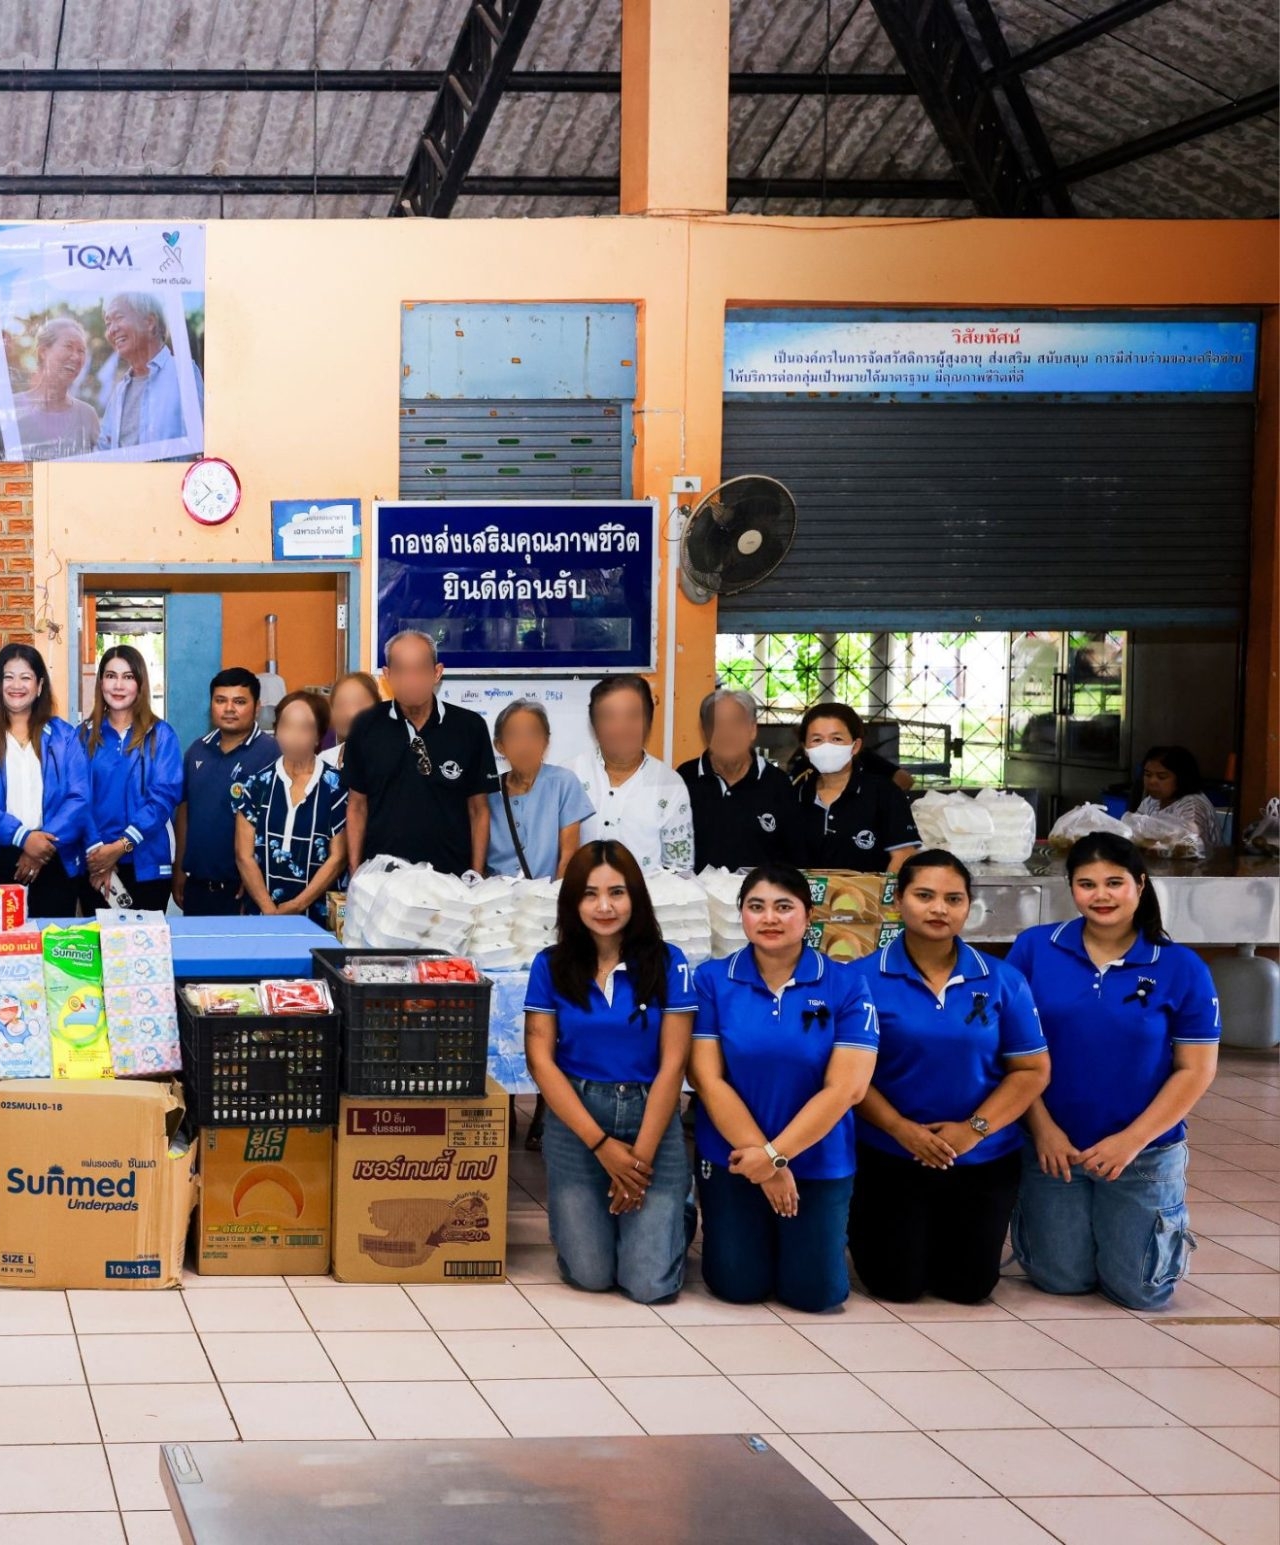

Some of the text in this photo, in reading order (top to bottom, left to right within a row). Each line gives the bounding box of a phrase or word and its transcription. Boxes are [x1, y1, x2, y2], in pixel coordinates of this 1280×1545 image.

[61, 244, 134, 271] TQM
[951, 327, 1021, 344] วิสัยทัศน์
[773, 350, 982, 369] เป็นองค์กรในการจัดสวัสดิการผู้สูงอายุ
[988, 348, 1031, 366] ส่งเสริม
[1037, 350, 1089, 368] สนับสนุน
[729, 367, 1025, 389] ให้บริการต่อกลุ่มเป้าหมายได้มาตรฐาน มีคุณภาพชีวิตที่ดี
[390, 522, 641, 565] กองส่งเสริมคุณภาพชีวิต
[443, 569, 587, 601] ยินดีต้อนรับ
[16, 939, 38, 952] แผ่น
[51, 946, 94, 962] Sunmed
[808, 998, 827, 1008] TQM
[0, 1101, 64, 1115] 02SMUL10-18
[352, 1110, 406, 1133] L 10 ชิ้น
[372, 1123, 417, 1136] รุ่นธรรมดา
[80, 1157, 157, 1172] แผ่นรองซับ ซันเมด
[352, 1149, 498, 1182] เซอร์เทนตี้ เทป
[6, 1166, 137, 1201] Sunmed
[66, 1199, 140, 1216] Underpads
[1, 1254, 35, 1265] SIZE L
[109, 1264, 124, 1276] 10
